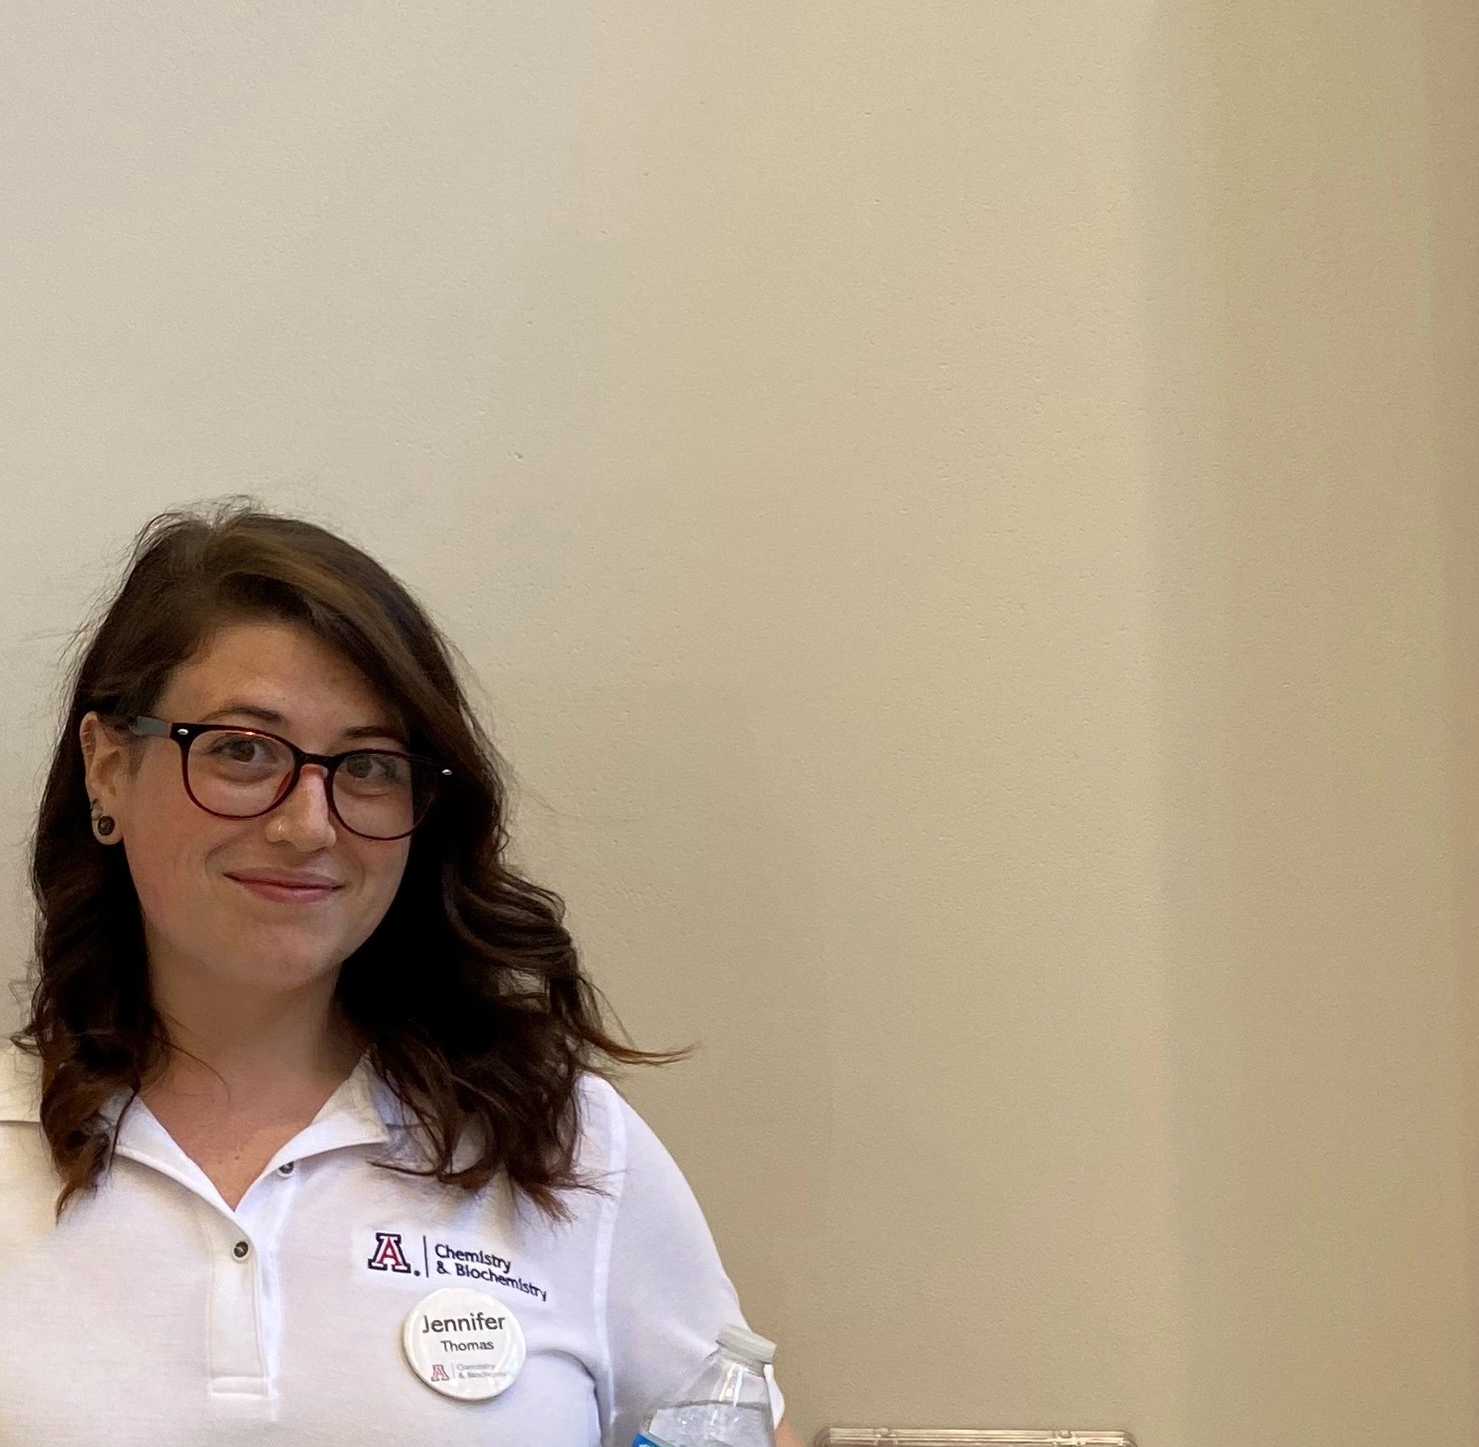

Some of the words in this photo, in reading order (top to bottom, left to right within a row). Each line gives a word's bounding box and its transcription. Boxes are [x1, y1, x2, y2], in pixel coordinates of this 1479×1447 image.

[435, 1244, 511, 1273] Chemistry
[436, 1260, 451, 1275] &
[455, 1262, 548, 1302] Biochemistry
[422, 1312, 505, 1334] Jennifer
[440, 1340, 494, 1352] Thomas
